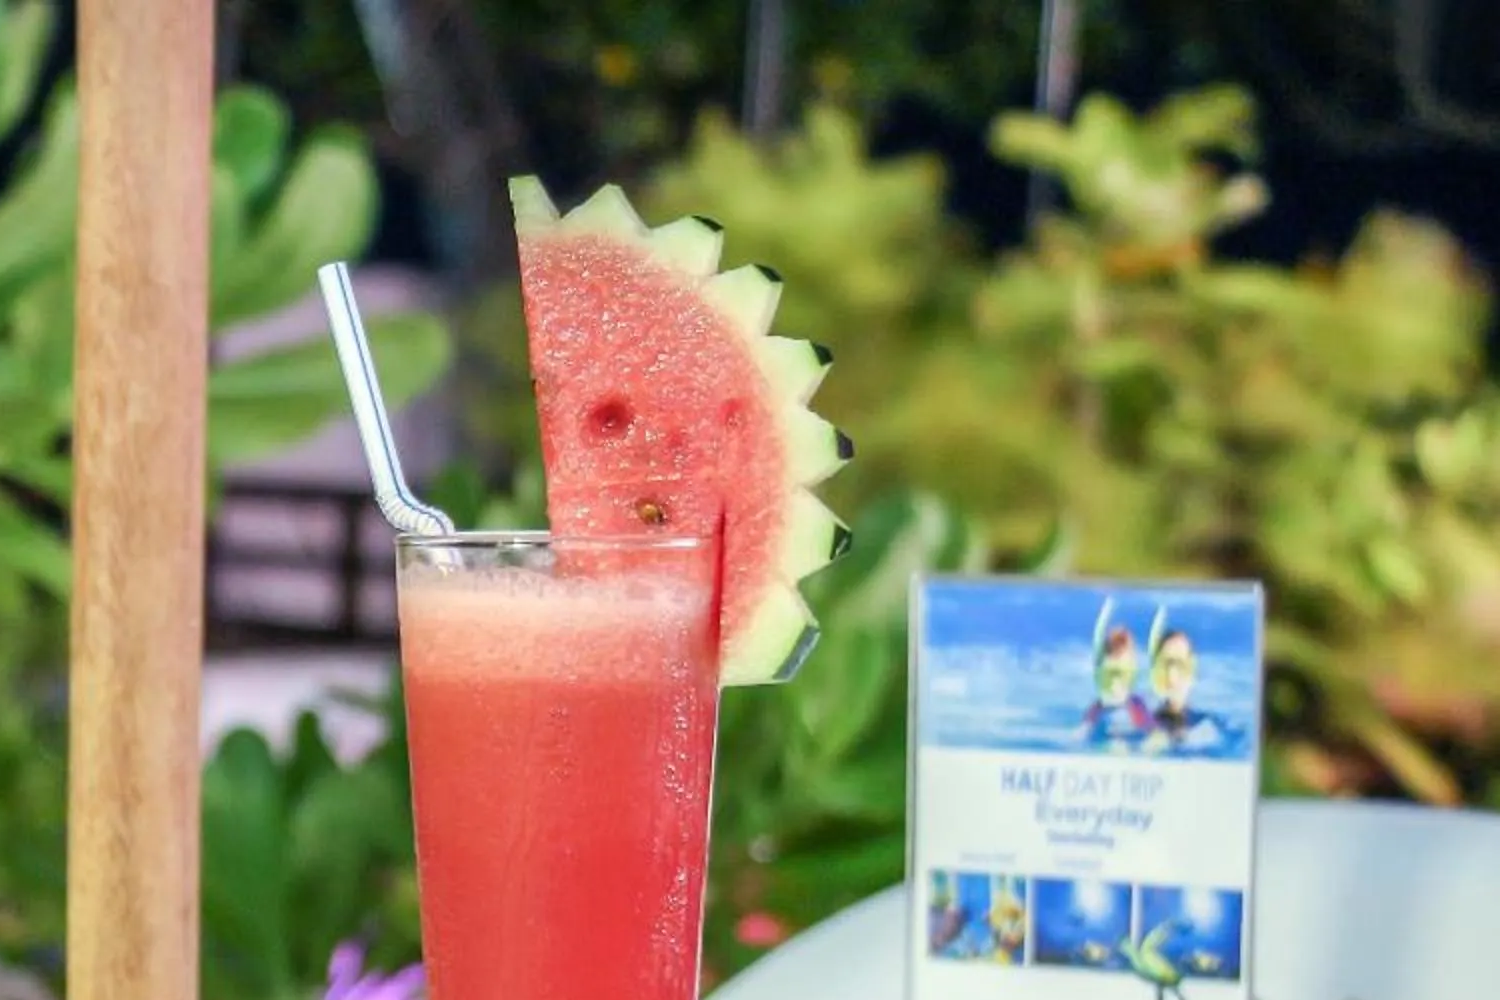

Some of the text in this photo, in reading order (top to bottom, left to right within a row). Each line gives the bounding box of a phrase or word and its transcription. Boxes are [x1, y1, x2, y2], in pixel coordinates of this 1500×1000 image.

[1001, 766, 1164, 800] HALF DAY TRIP
[1034, 800, 1154, 831] Everyday
